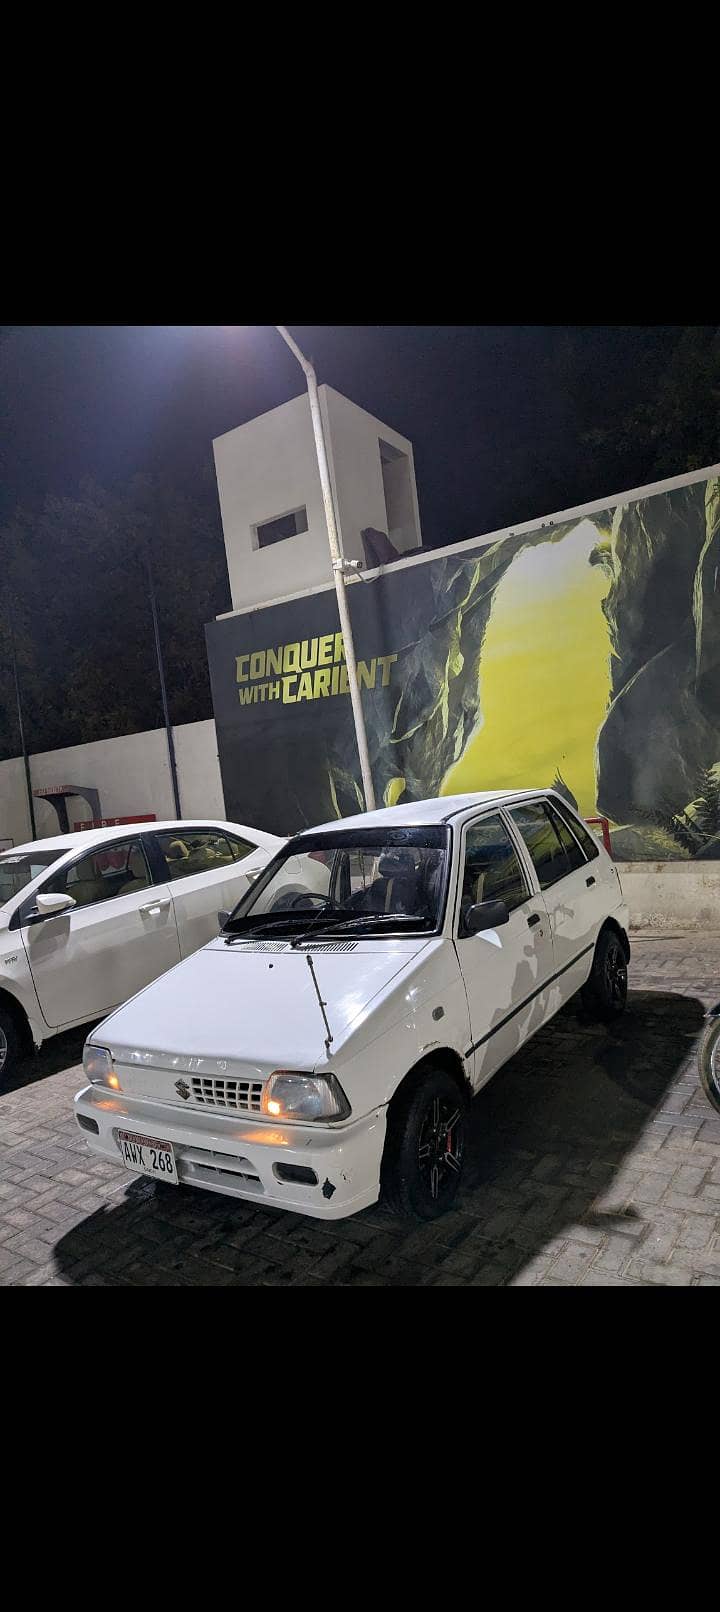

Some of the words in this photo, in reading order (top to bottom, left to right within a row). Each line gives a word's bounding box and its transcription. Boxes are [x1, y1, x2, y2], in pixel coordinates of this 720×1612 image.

[235, 632, 346, 683] CONQUER
[239, 679, 280, 705] WITH
[124, 1142, 145, 1166] AWX
[150, 1149, 173, 1173] 268
